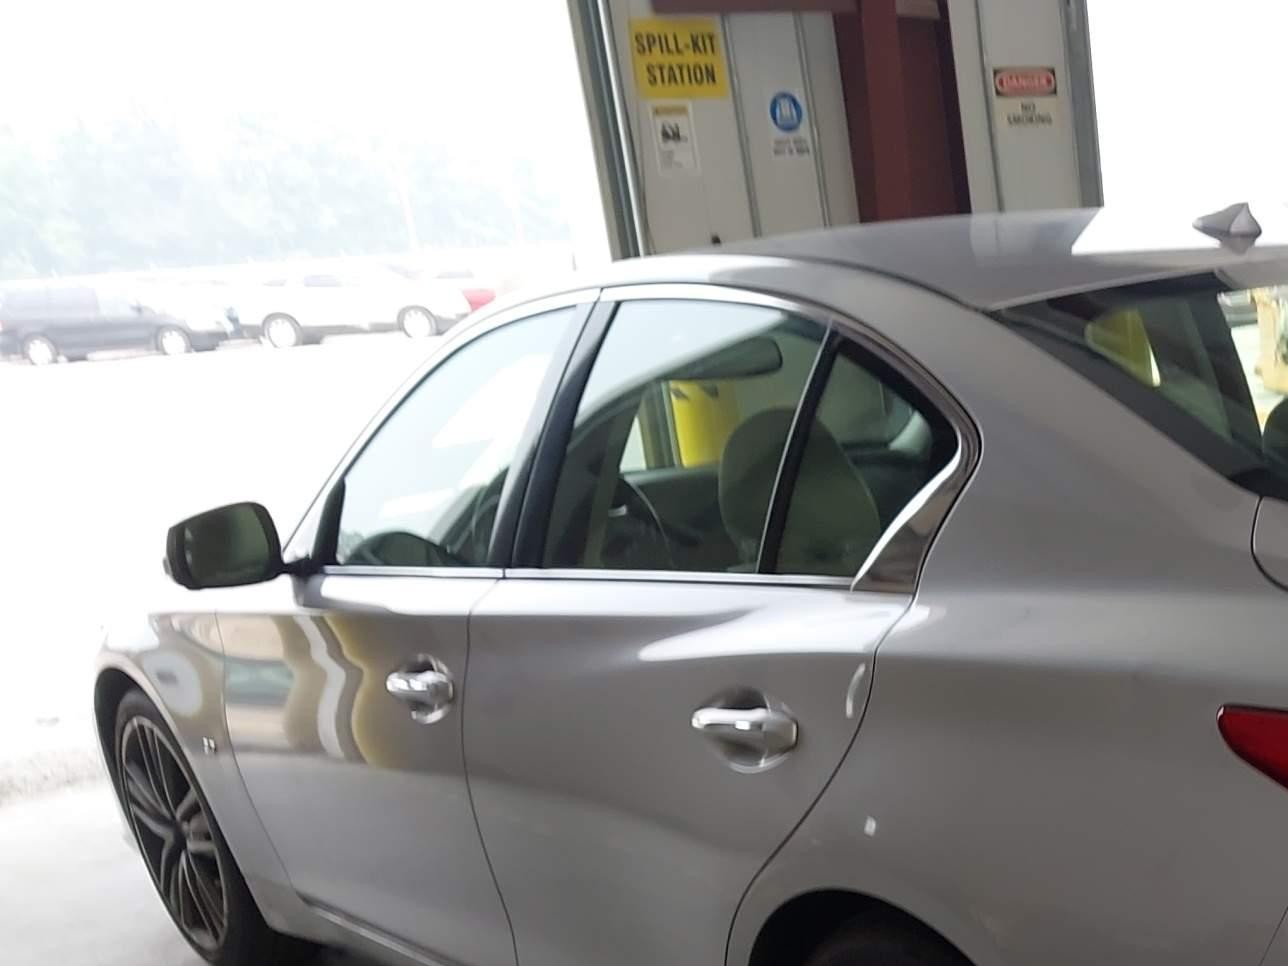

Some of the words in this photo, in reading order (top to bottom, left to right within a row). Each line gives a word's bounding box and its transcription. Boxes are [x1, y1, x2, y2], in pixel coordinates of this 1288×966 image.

[634, 31, 716, 56] SPILL-KIT
[646, 63, 717, 87] STATION
[1002, 75, 1047, 90] DANGER
[1020, 103, 1036, 113] NO
[1006, 113, 1053, 126] SMOKING
